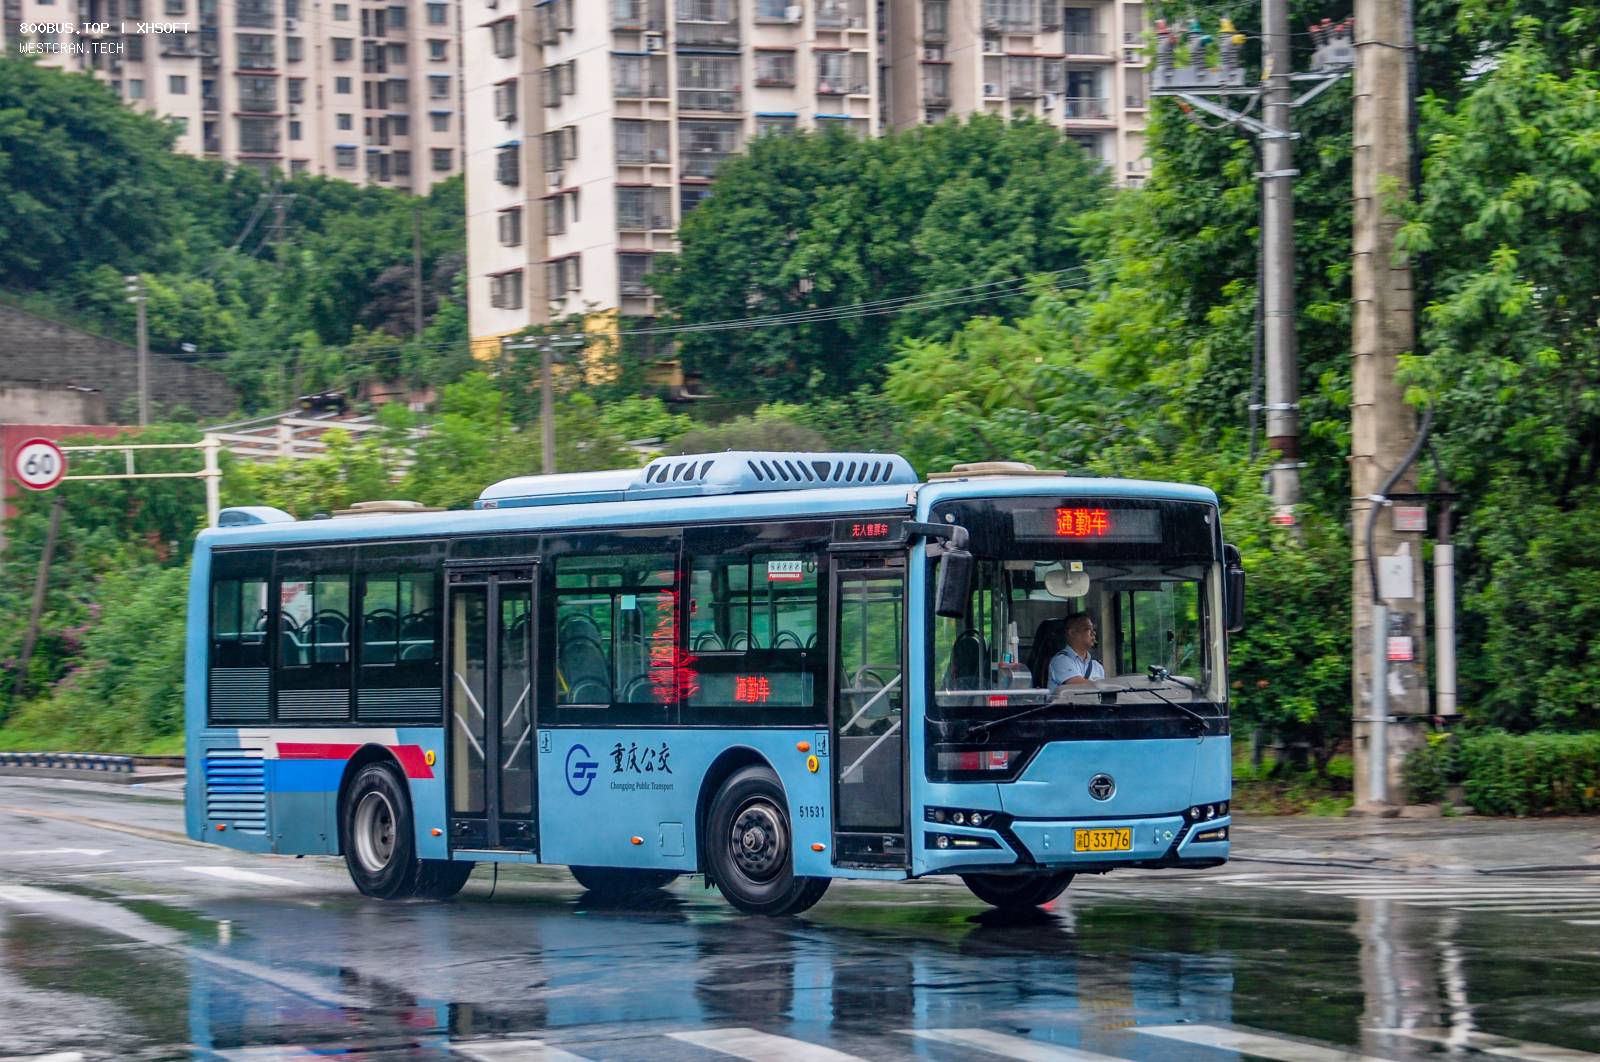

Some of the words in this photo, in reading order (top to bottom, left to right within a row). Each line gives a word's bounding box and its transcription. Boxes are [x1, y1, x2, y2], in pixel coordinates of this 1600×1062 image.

[25, 454, 54, 475] 60
[851, 523, 889, 537] 无人售票车
[1056, 508, 1108, 536] 通勤车
[609, 742, 673, 774] 重庆公交
[610, 781, 636, 792] Chongqing
[636, 781, 650, 790] Public
[651, 781, 674, 792] Transport
[799, 806, 825, 818] 51531
